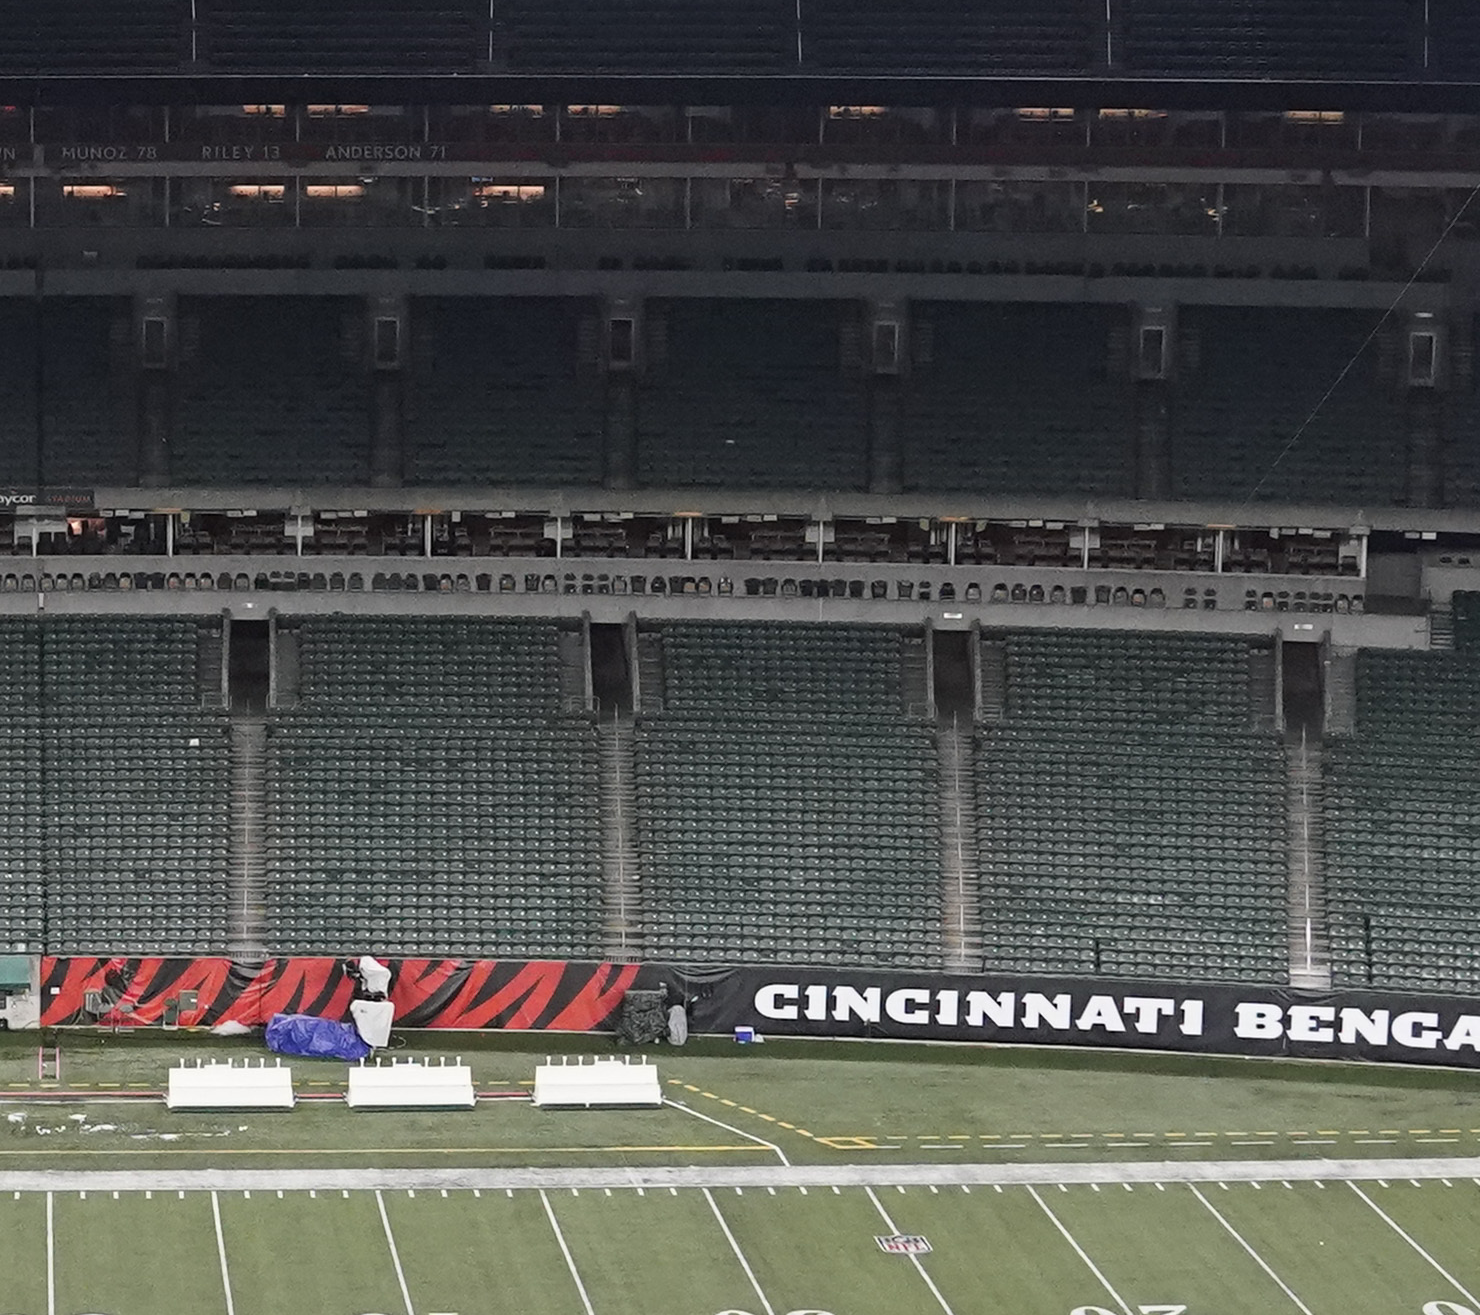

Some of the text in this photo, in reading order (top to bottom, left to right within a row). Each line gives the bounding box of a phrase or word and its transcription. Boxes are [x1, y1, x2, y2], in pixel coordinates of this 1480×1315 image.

[136, 146, 157, 159] 78
[201, 145, 280, 160] RILEY 13
[325, 145, 446, 159] ANDERSON 71
[754, 983, 1204, 1037] CINCINNATI
